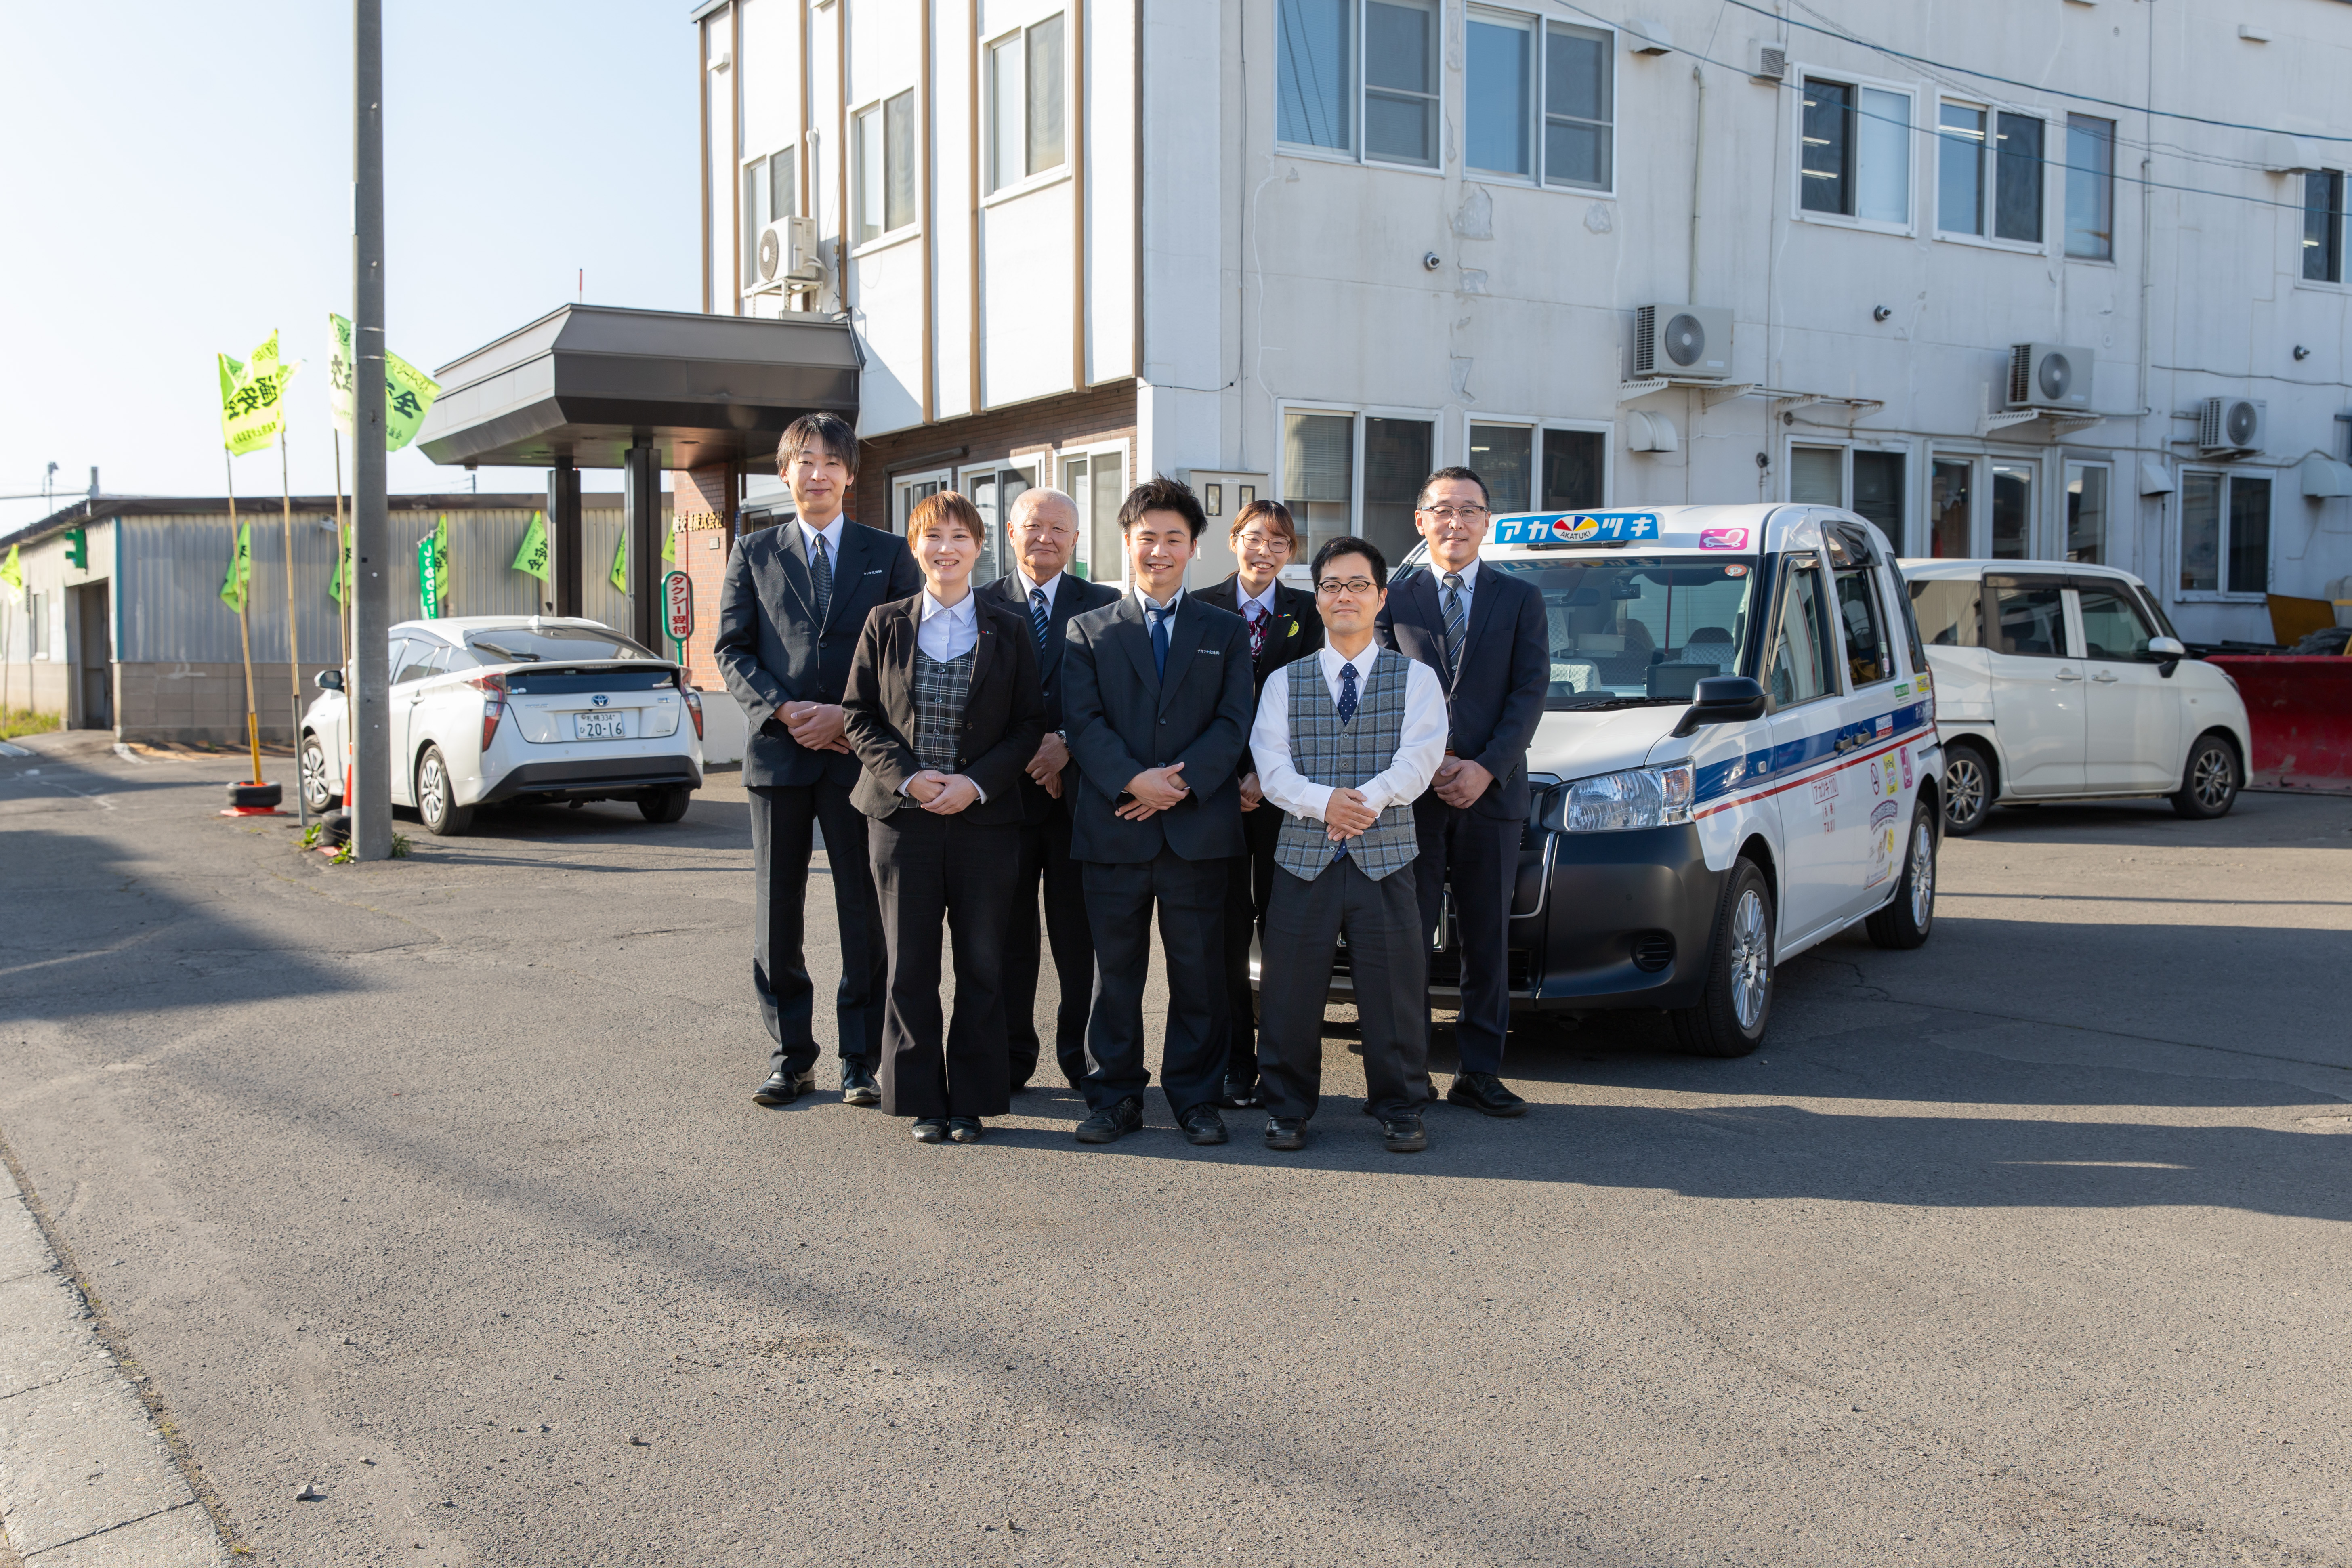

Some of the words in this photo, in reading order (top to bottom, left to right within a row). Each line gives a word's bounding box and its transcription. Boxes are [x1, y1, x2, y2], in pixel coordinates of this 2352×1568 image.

[1502, 517, 1652, 541] アカツキ
[1560, 531, 1591, 539] AKATUKI
[671, 577, 686, 634] タクシー受付
[587, 722, 622, 736] 20-16
[1824, 819, 1835, 836] TAXI
